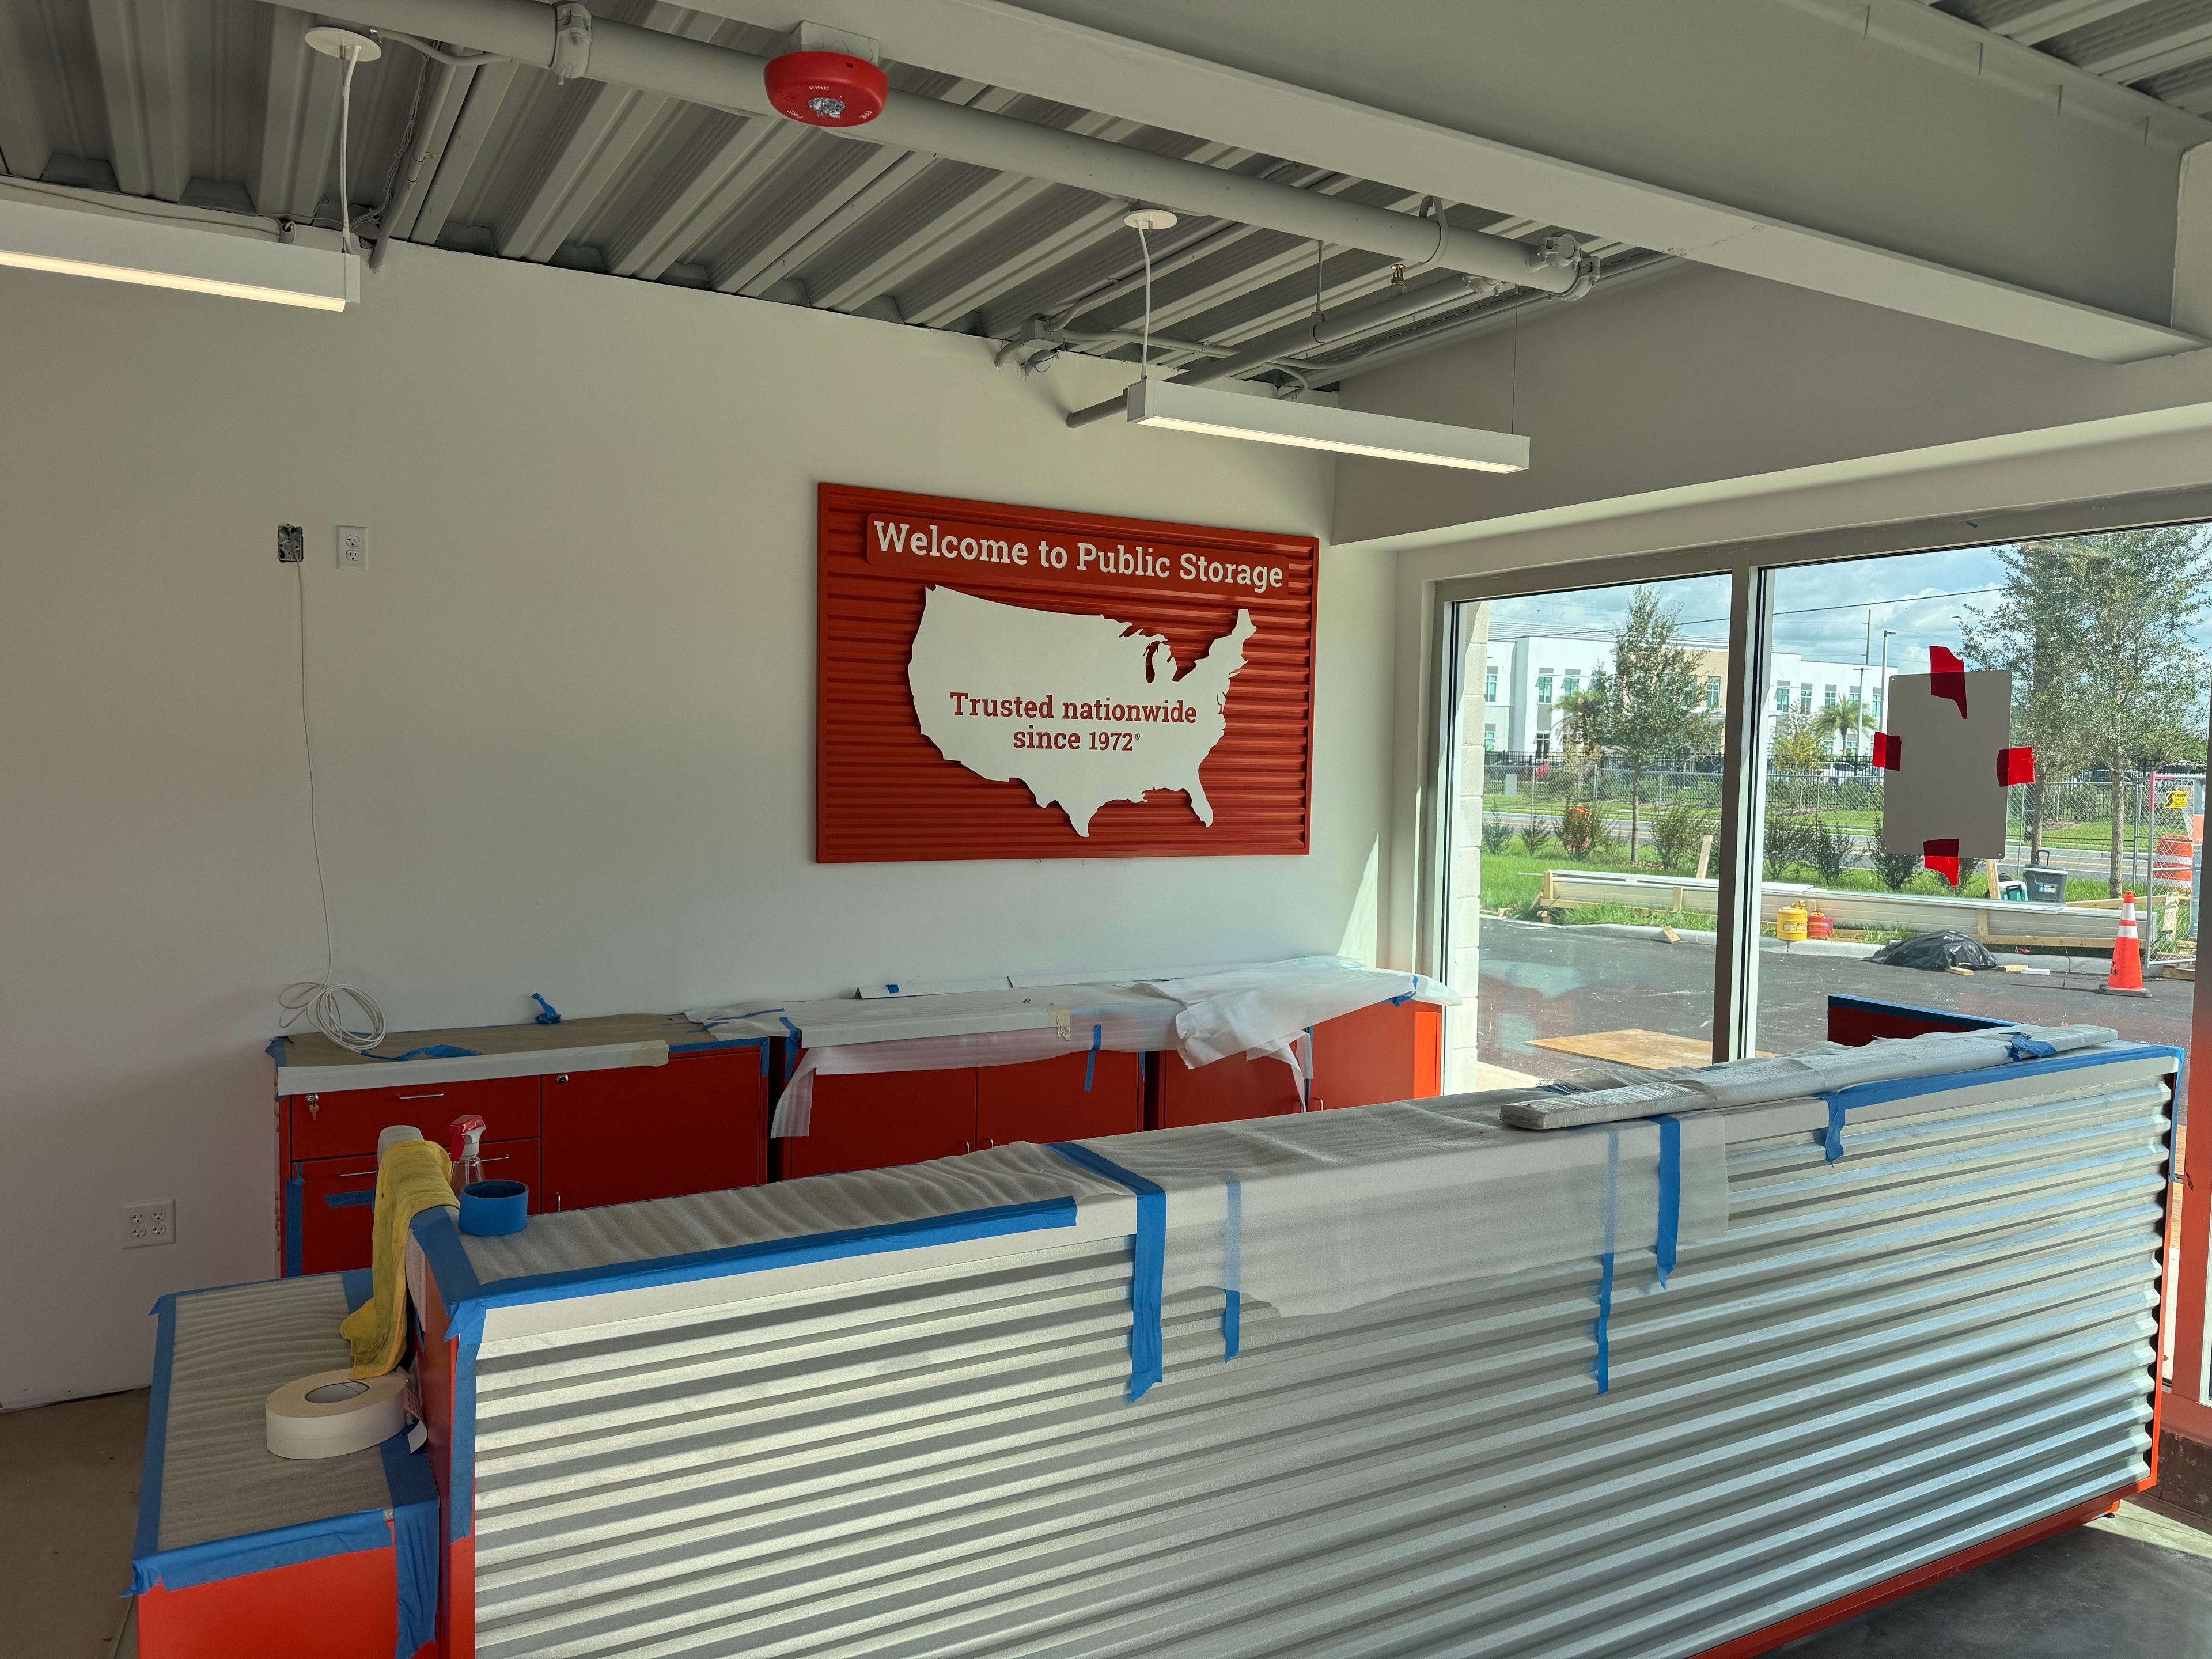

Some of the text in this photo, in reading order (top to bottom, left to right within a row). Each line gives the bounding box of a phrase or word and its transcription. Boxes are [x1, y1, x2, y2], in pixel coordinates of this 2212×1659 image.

[874, 520, 1283, 593] Welcome to Public Storage
[949, 692, 1197, 724] Trusted nationwide
[1013, 725, 1081, 750] since
